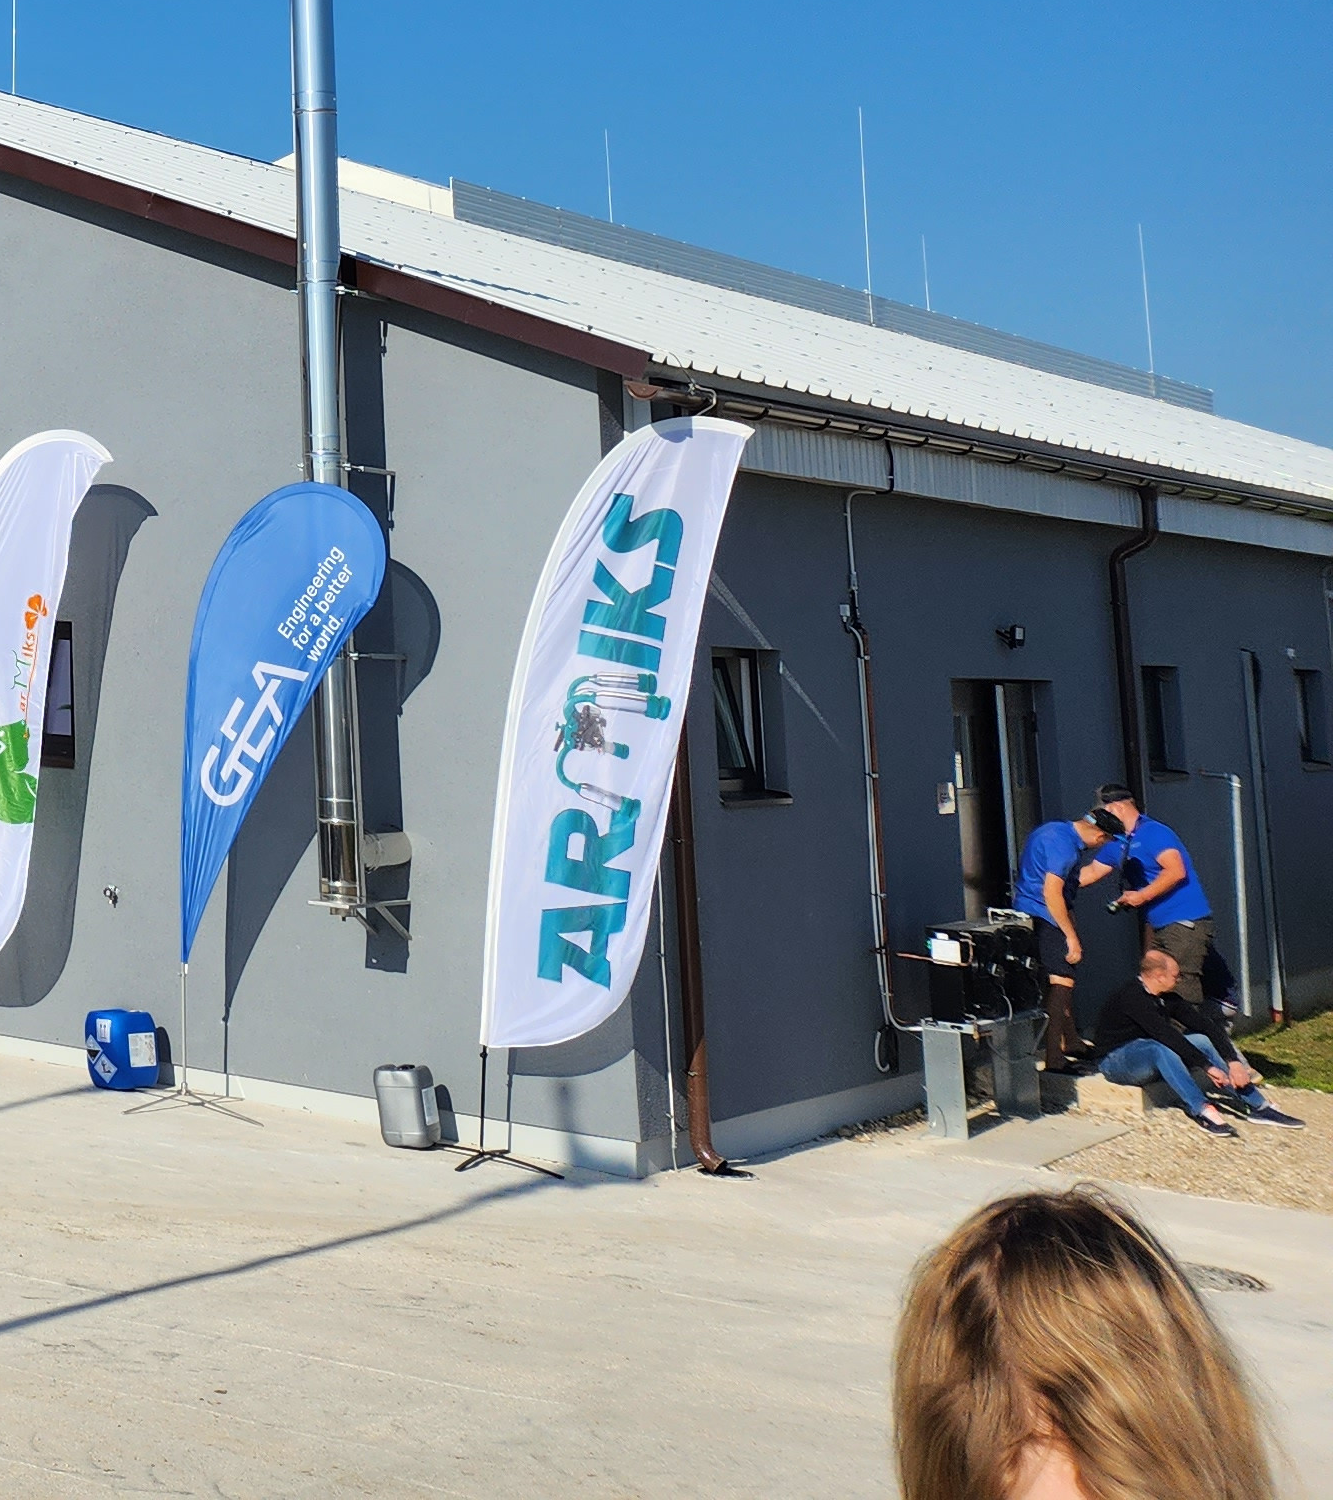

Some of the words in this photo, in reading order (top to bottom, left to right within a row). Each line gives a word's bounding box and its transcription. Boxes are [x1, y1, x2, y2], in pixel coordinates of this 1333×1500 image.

[277, 546, 345, 639] Engineering
[314, 563, 353, 614] better
[292, 624, 312, 651] for
[307, 615, 344, 662] world.
[310, 613, 321, 626] a
[200, 661, 310, 807] GEA
